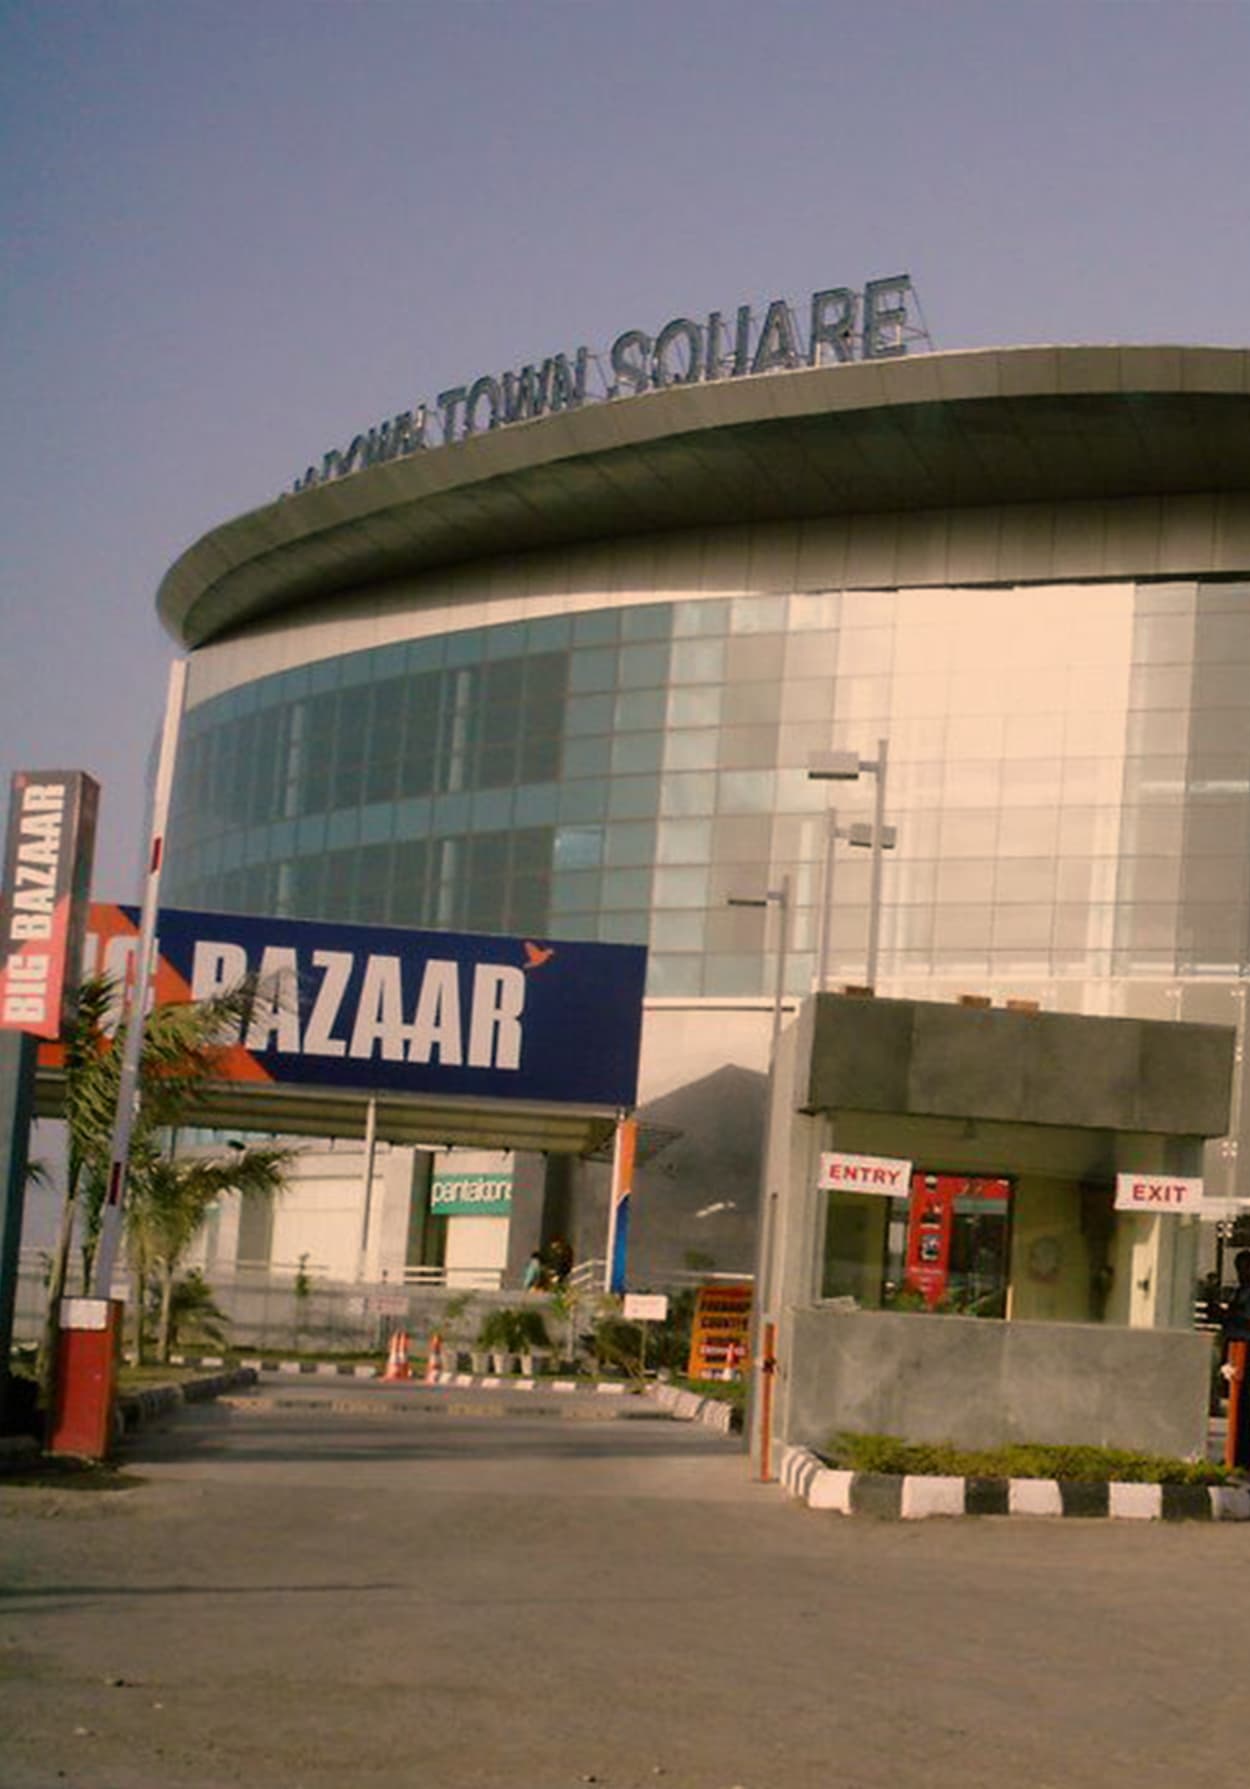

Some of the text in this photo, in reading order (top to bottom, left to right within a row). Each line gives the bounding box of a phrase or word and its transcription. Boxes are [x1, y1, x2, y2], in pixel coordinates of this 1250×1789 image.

[610, 274, 911, 395] SQUARE
[3, 784, 66, 1022] BIG BAZAAR
[192, 940, 526, 1071] BAZAAR
[829, 1164, 902, 1186] ENTRY
[1132, 1184, 1188, 1204] EXIT
